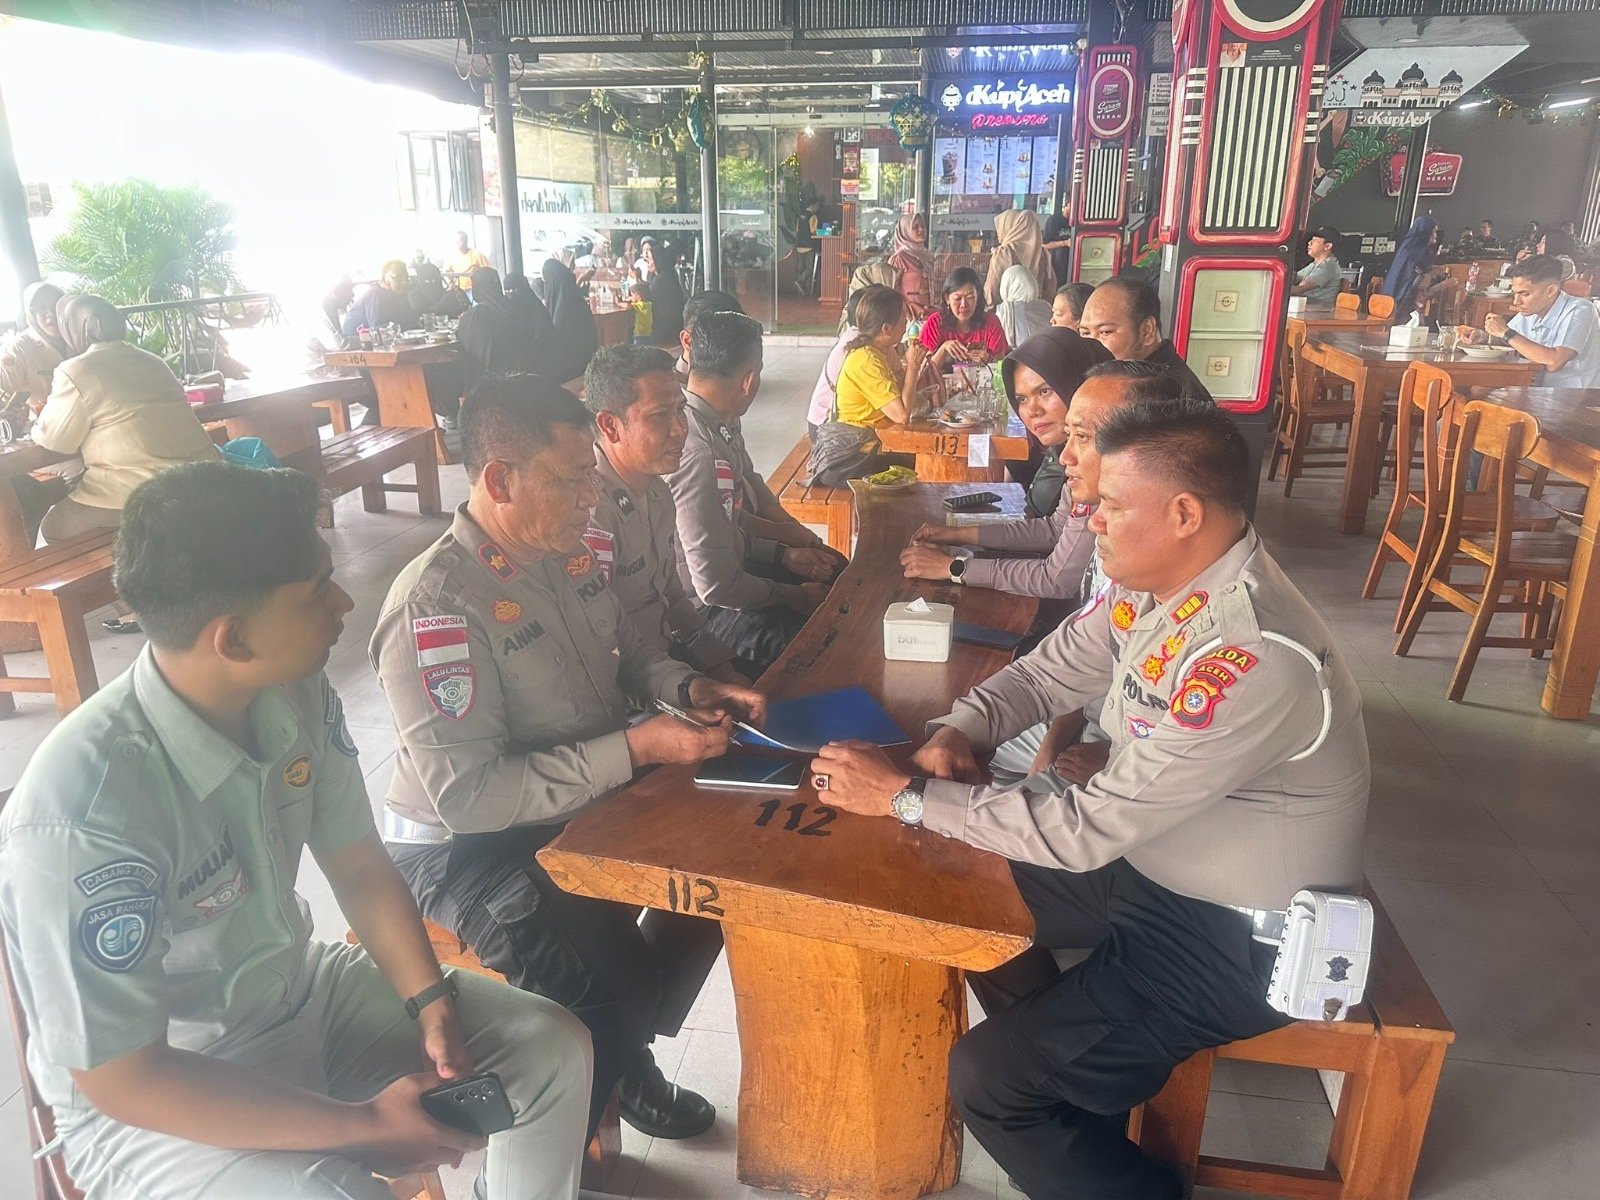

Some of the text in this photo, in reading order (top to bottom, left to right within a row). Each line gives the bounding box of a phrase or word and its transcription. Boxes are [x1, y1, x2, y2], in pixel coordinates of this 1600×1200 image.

[934, 435, 958, 455] 113
[415, 617, 465, 629] INDONESIA
[503, 619, 546, 656] ANAM
[1198, 665, 1229, 681] ACEH
[754, 799, 838, 836] 112
[86, 866, 131, 888] CABANG
[667, 876, 724, 917] 112
[88, 908, 114, 925] JASA
